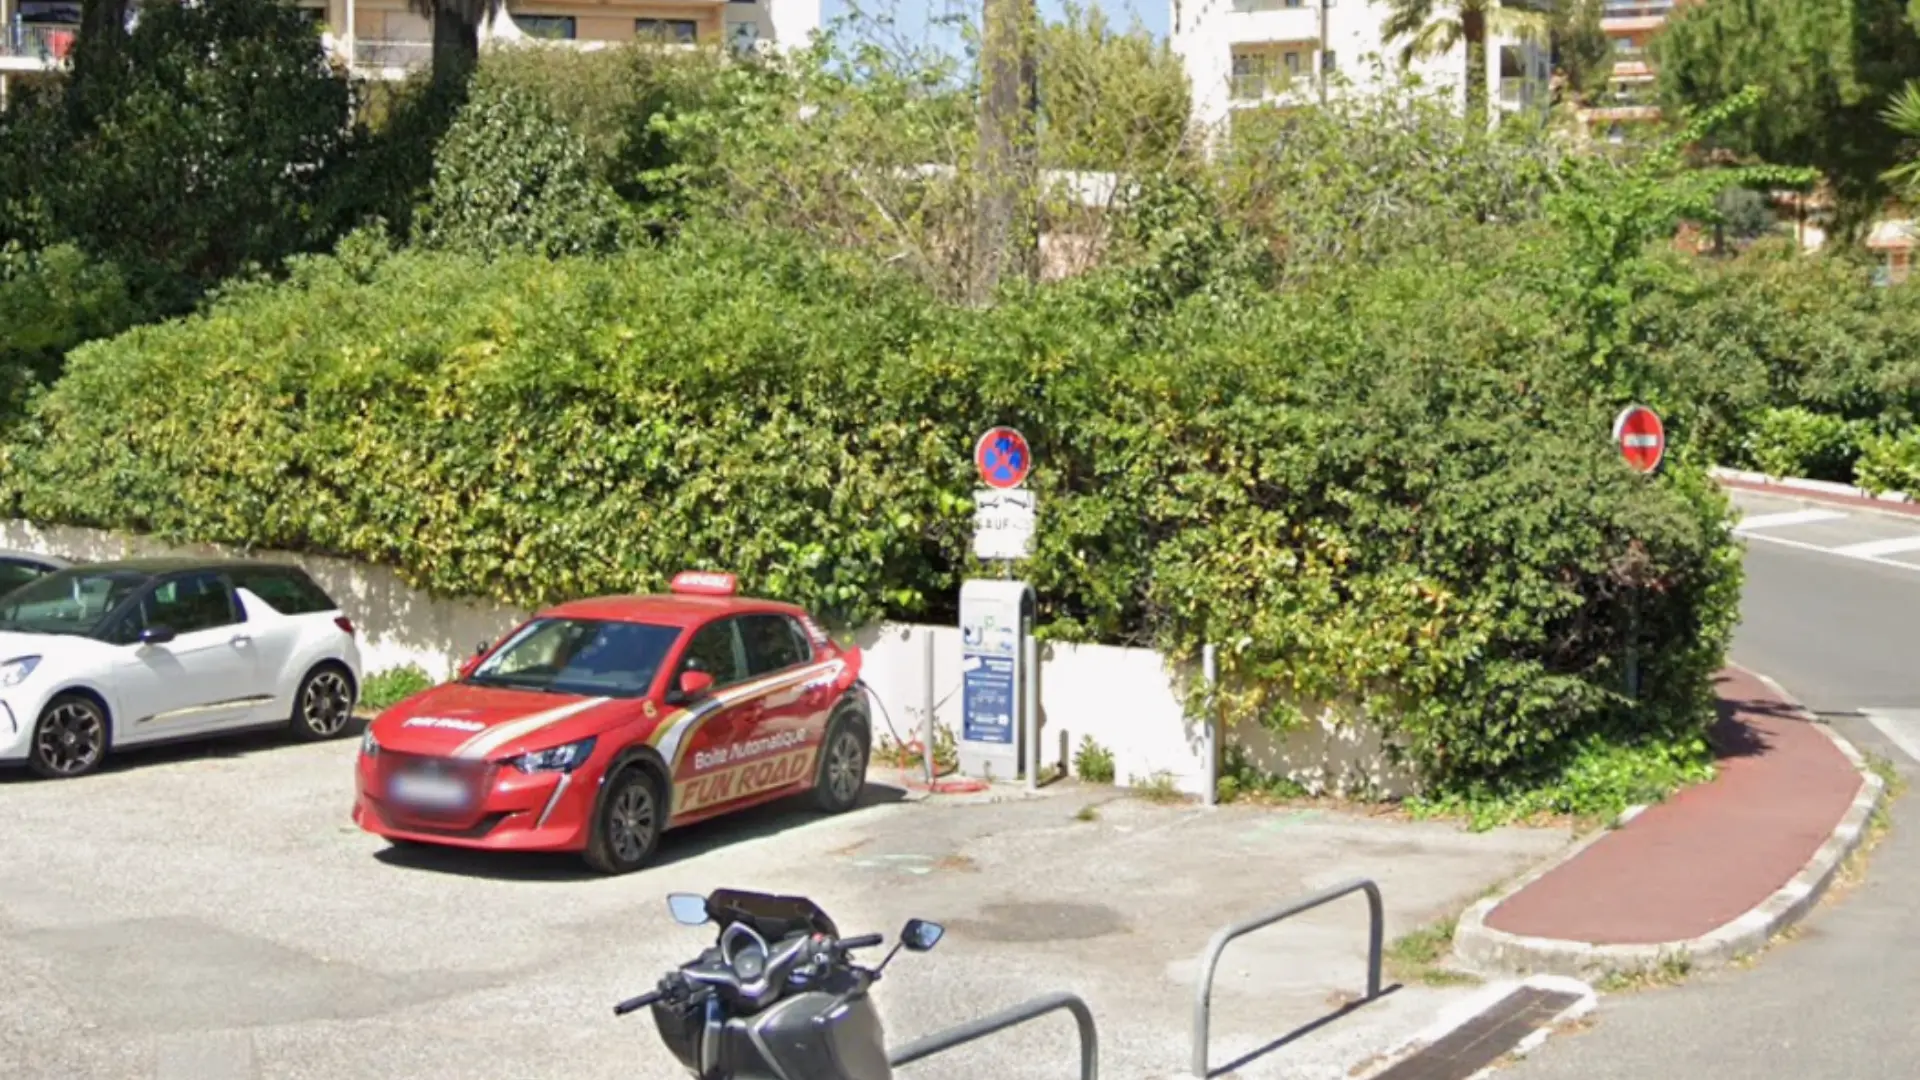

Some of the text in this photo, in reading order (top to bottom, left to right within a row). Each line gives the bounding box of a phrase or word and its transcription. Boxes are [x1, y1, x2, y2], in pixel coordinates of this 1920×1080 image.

[729, 728, 806, 760] Automatique
[680, 753, 808, 810] FUN ROAD
